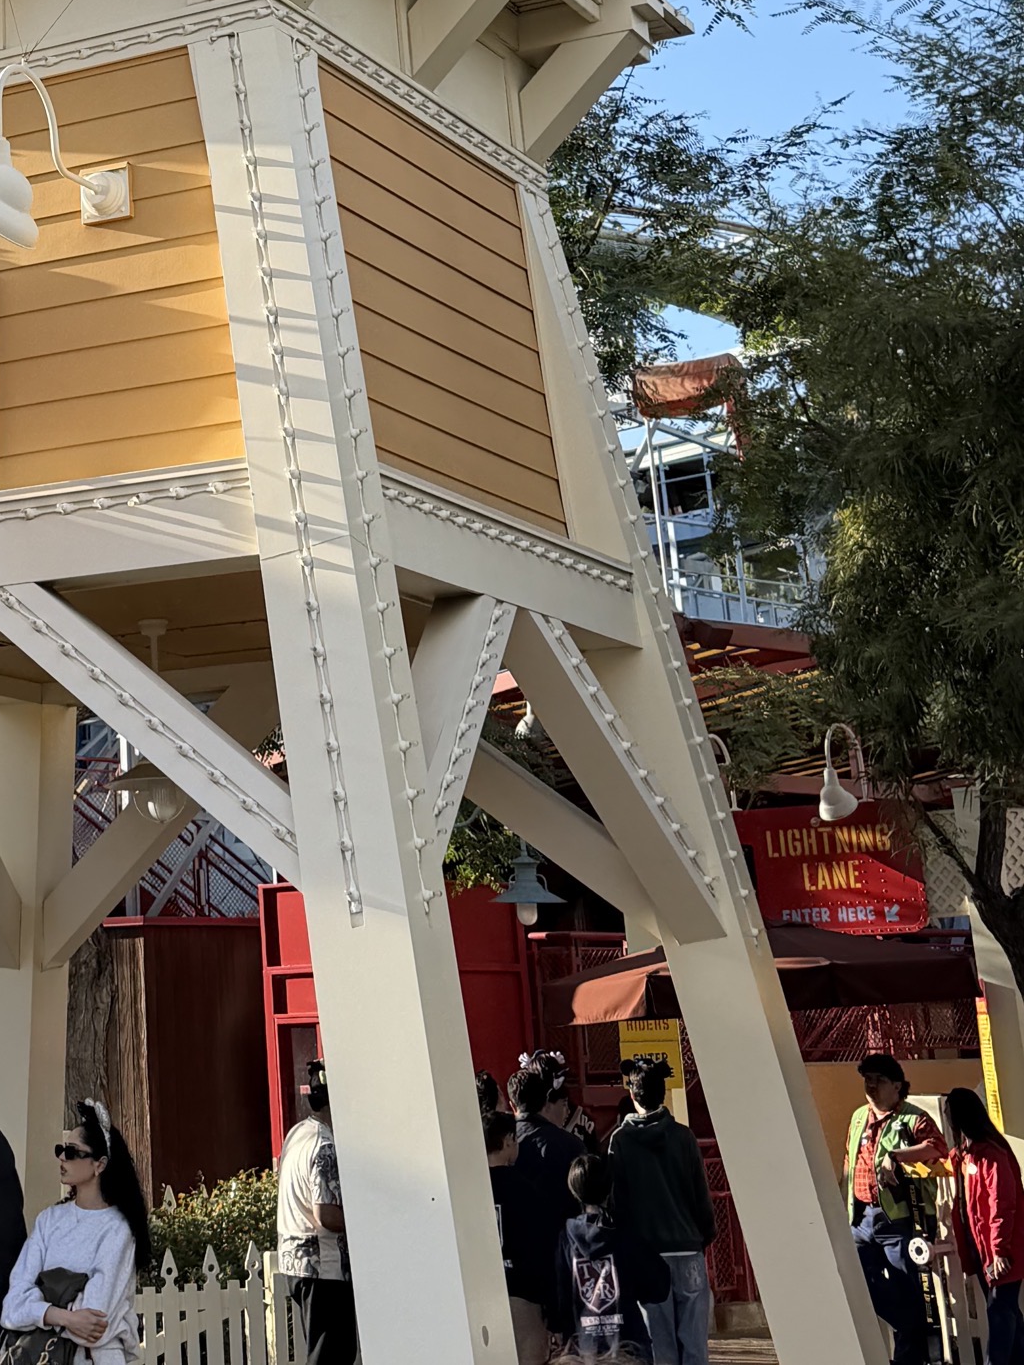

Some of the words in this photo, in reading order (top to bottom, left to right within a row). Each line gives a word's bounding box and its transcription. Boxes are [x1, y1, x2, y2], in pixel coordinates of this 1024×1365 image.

[766, 823, 891, 858] LIGHTNING
[802, 860, 862, 891] LANE
[782, 908, 831, 924] ENTER
[837, 906, 876, 923] HERE
